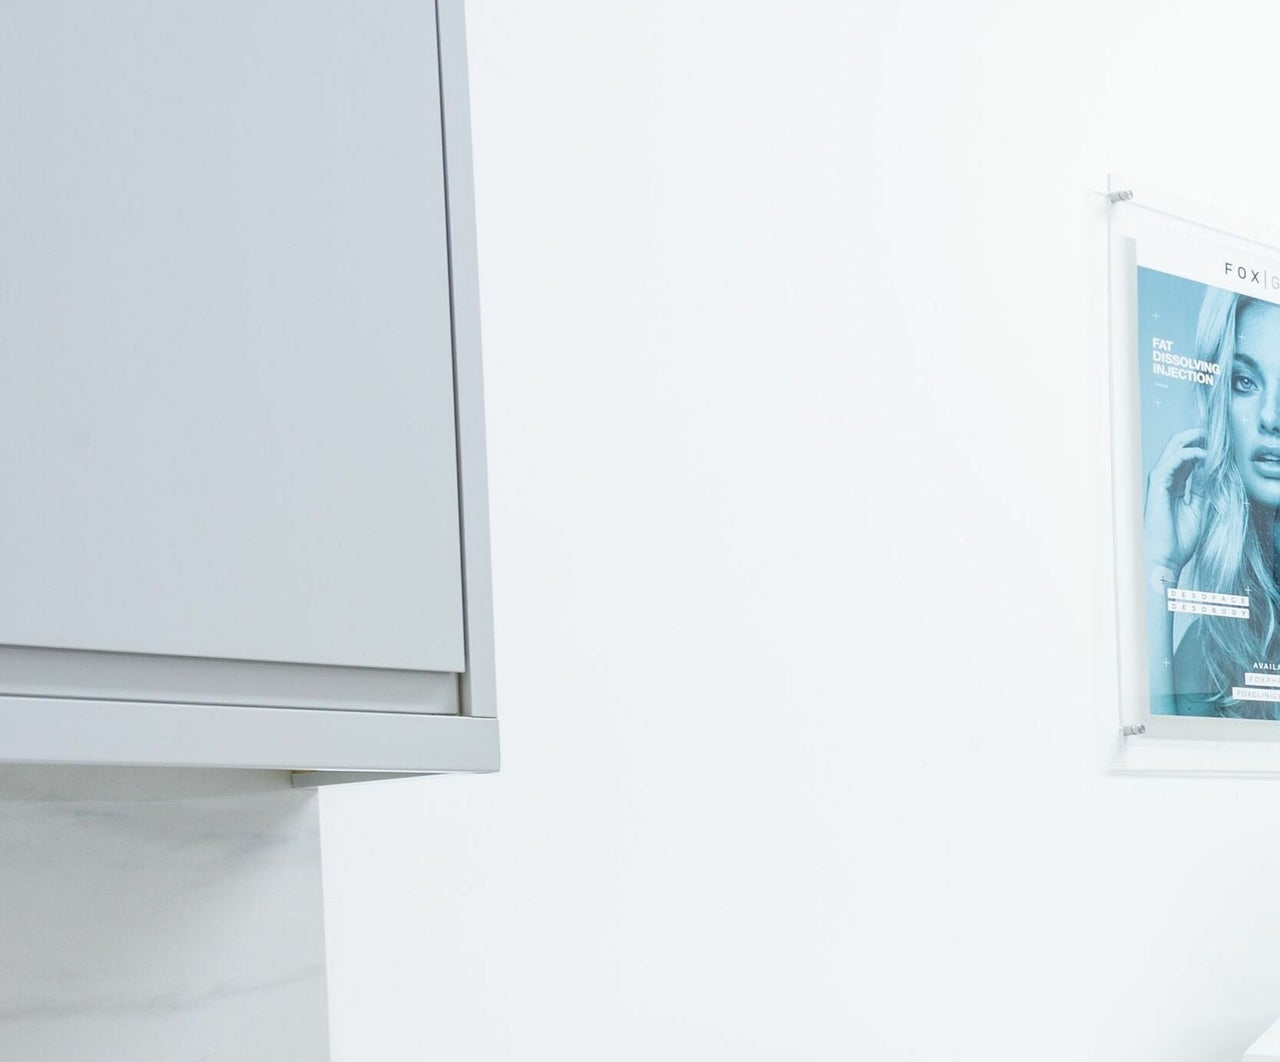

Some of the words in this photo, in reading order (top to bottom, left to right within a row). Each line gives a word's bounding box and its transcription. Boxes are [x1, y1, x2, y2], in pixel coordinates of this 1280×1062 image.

[1152, 337, 1174, 352] FAT
[1152, 350, 1221, 375] DISSOLVING
[1153, 363, 1214, 385] INJECTION
